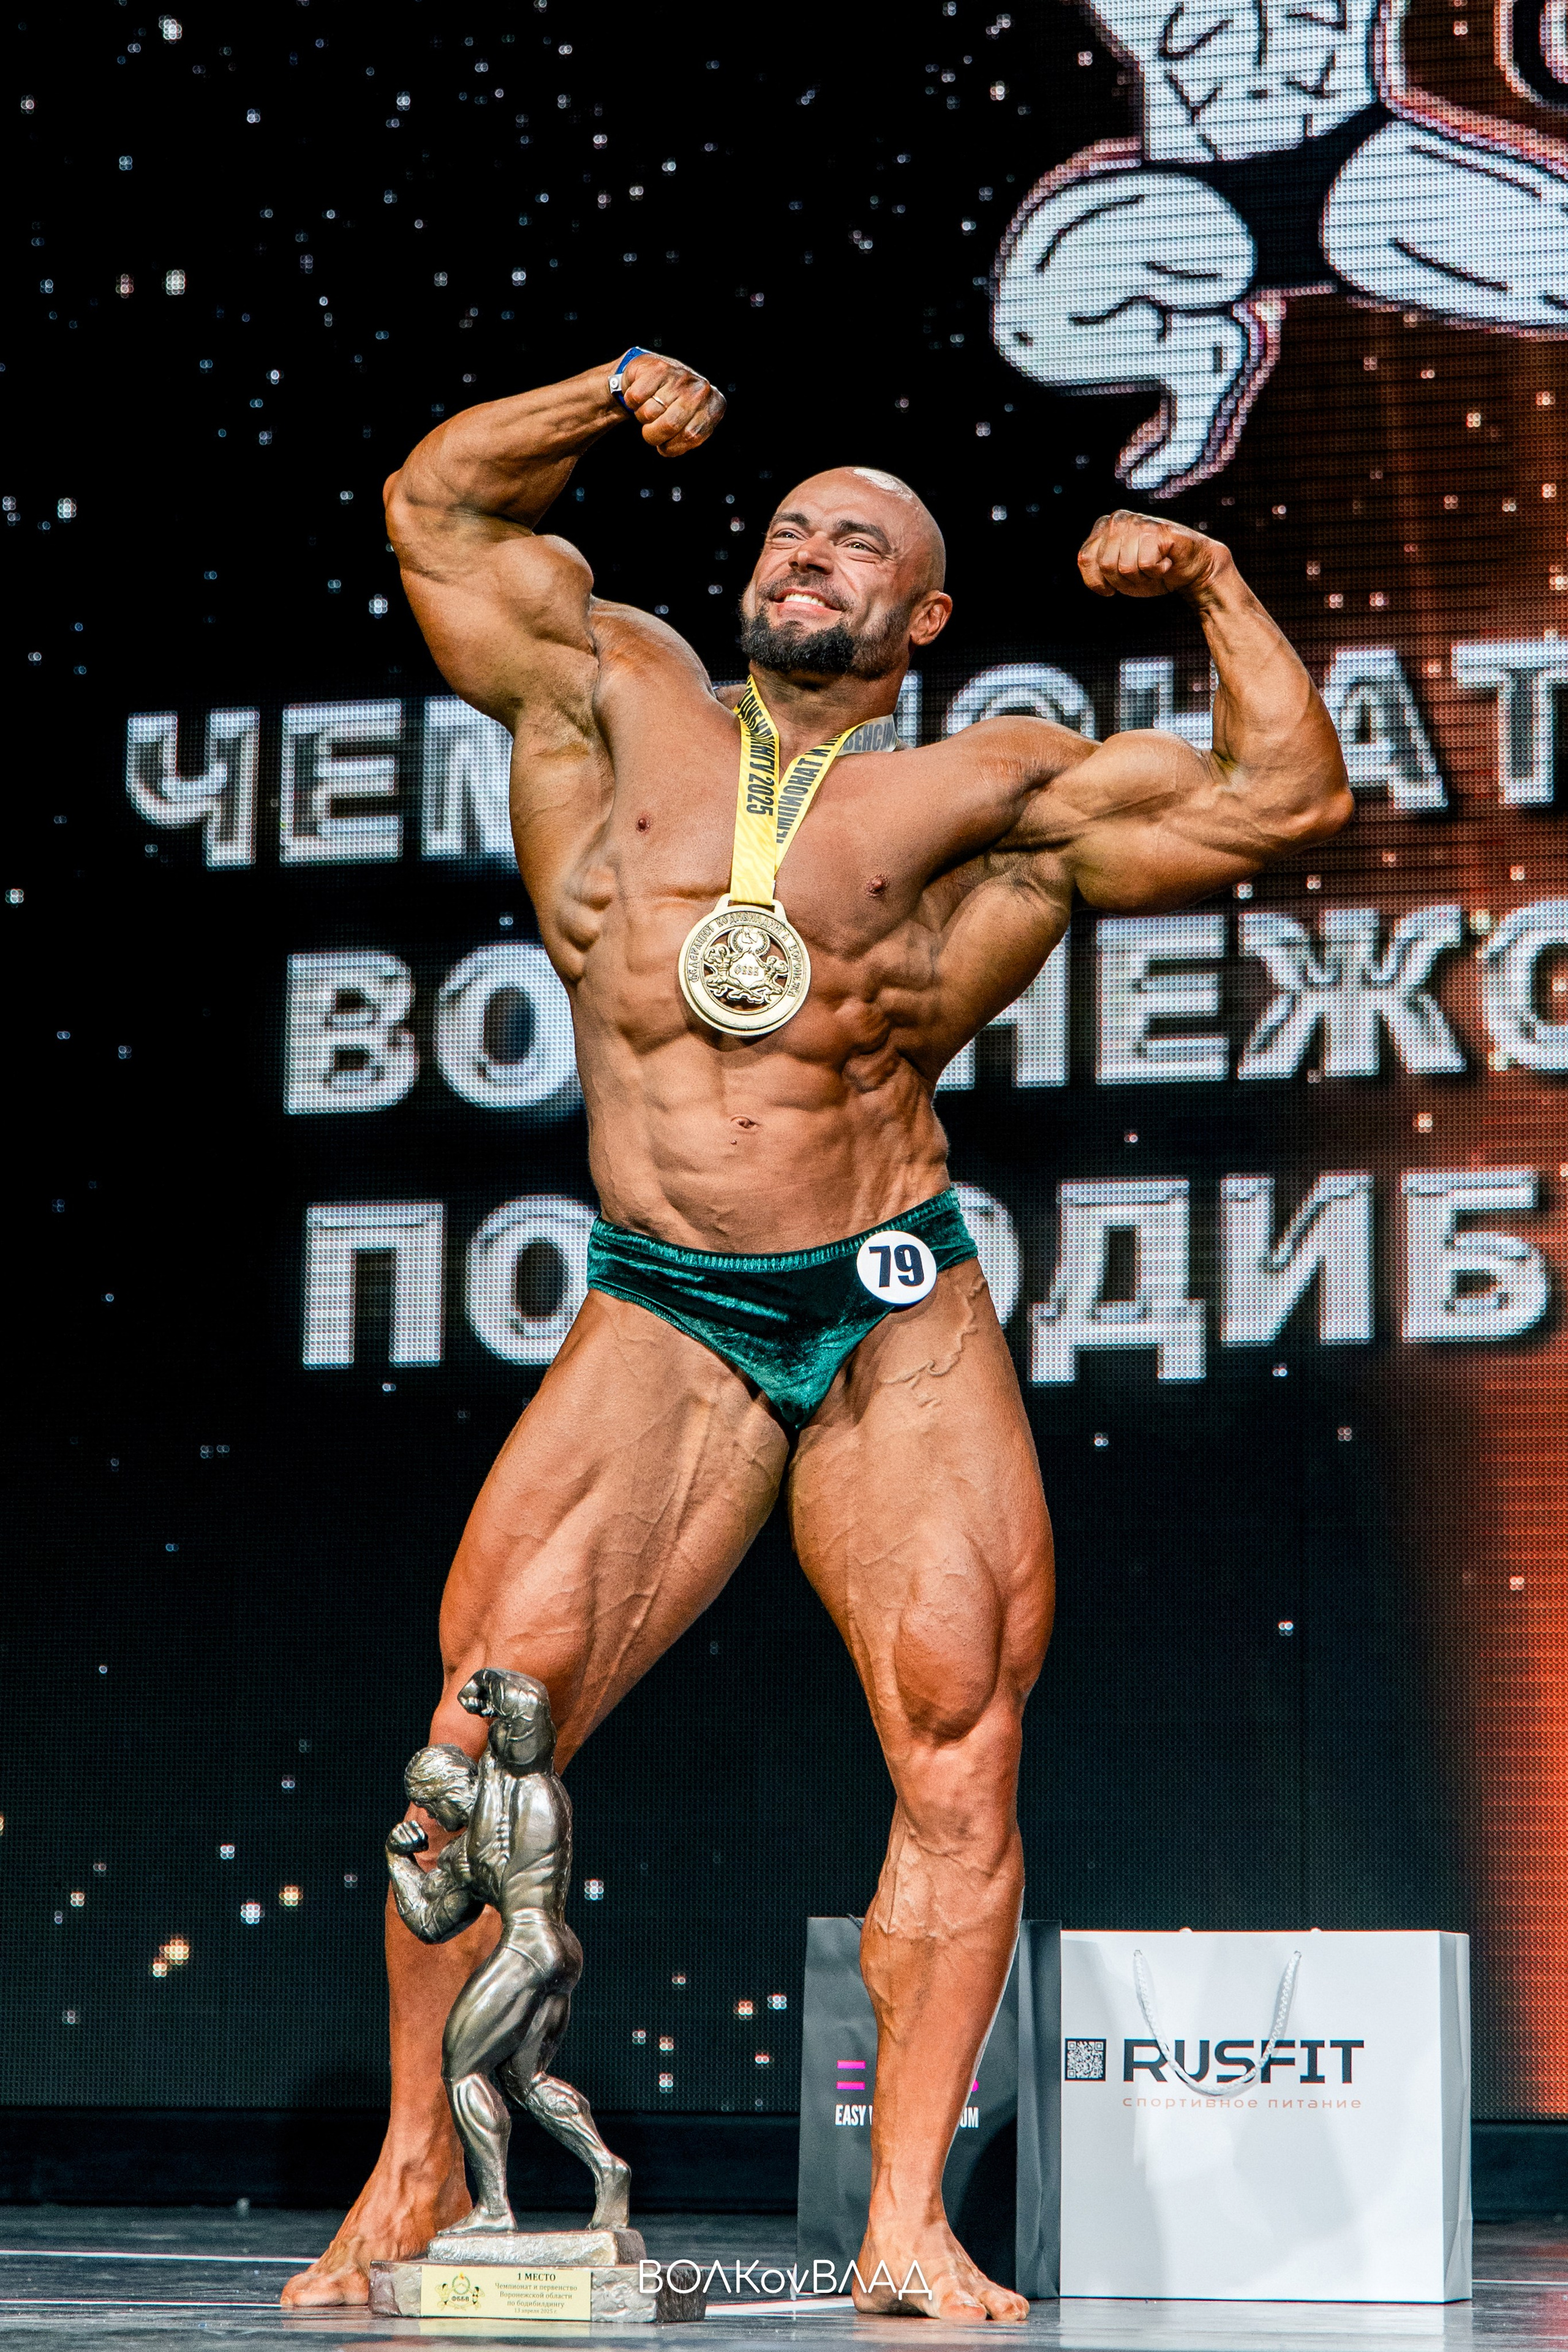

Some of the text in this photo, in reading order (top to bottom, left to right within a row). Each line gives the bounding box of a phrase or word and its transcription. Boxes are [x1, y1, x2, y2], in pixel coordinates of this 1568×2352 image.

[747, 773, 775, 816] 2025
[869, 1244, 924, 1287] 79
[1123, 2038, 1365, 2084] RUSFIT
[1122, 2097, 1362, 2109] спортивное питание
[835, 2104, 866, 2126] EASY
[524, 2273, 556, 2282] МЕСТО
[500, 2291, 544, 2299] Воронежской
[517, 2300, 565, 2309] бодибилдингу
